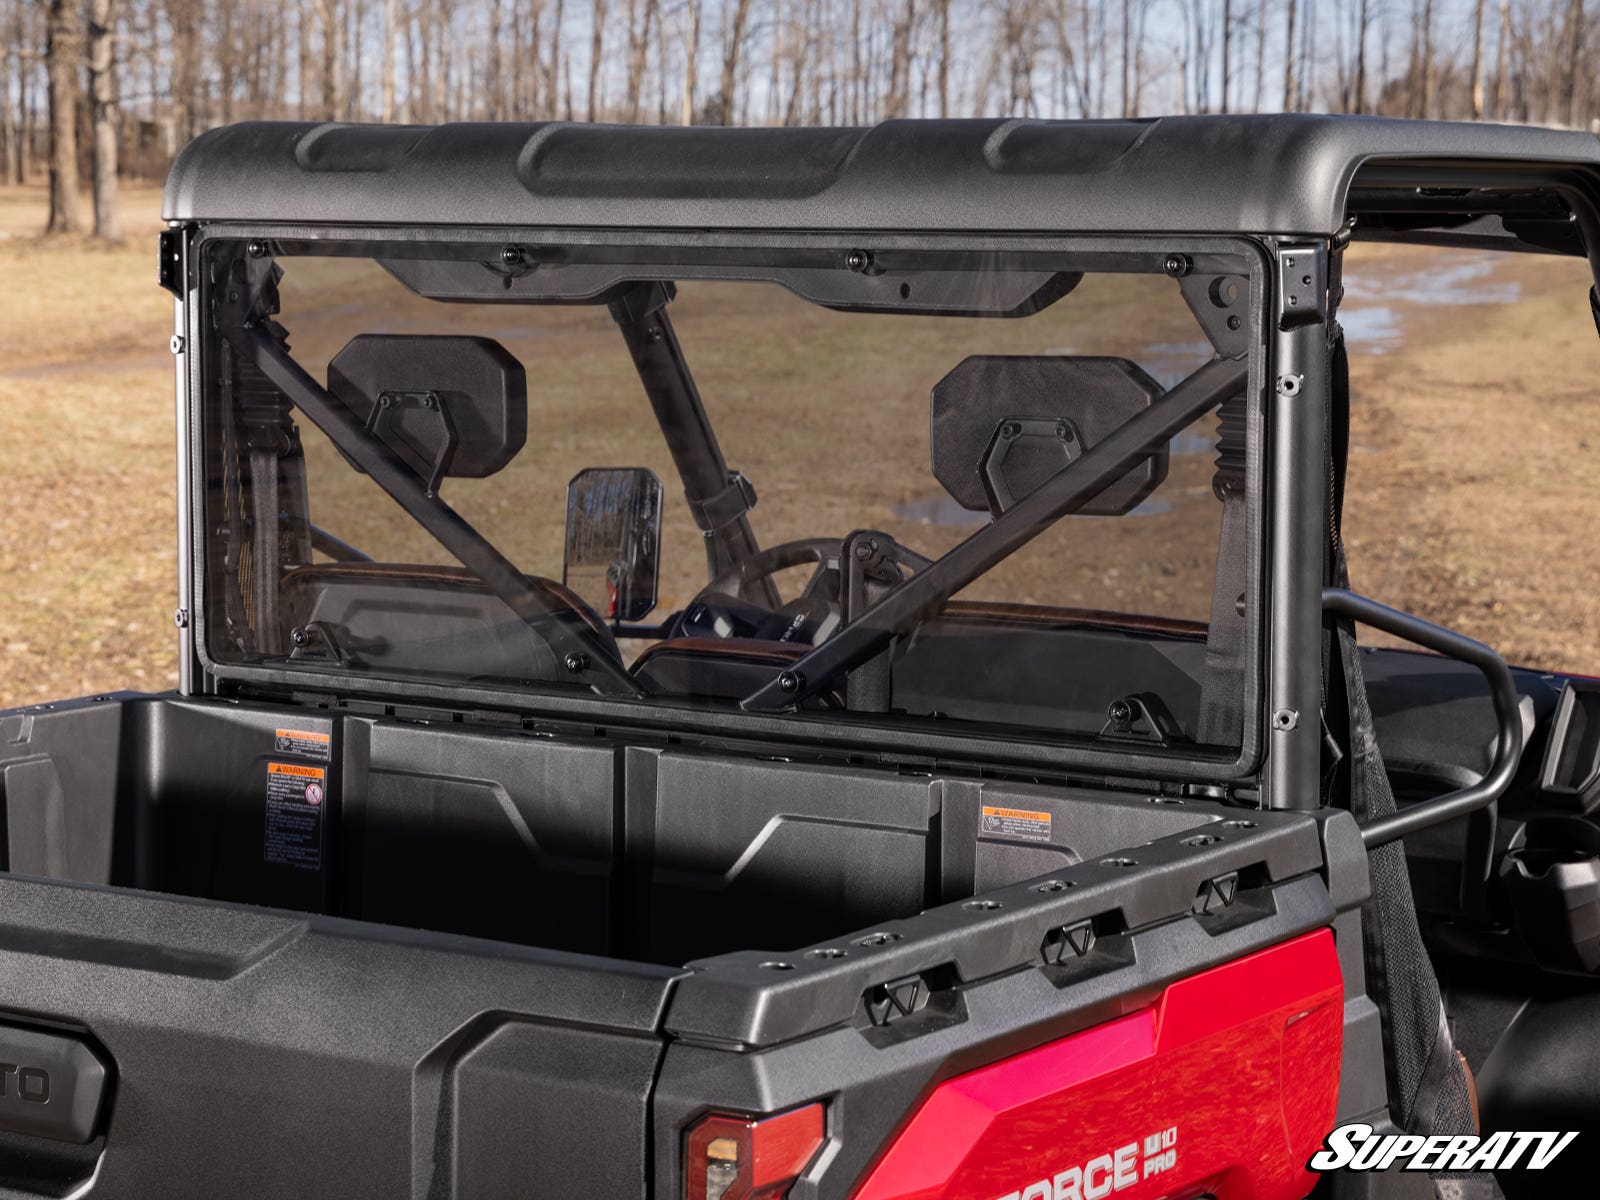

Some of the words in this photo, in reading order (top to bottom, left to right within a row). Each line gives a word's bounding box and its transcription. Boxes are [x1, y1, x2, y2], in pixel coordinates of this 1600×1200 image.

[282, 765, 316, 777] WARNING
[1000, 809, 1040, 821] WARNING
[1144, 1148, 1177, 1179] PRO
